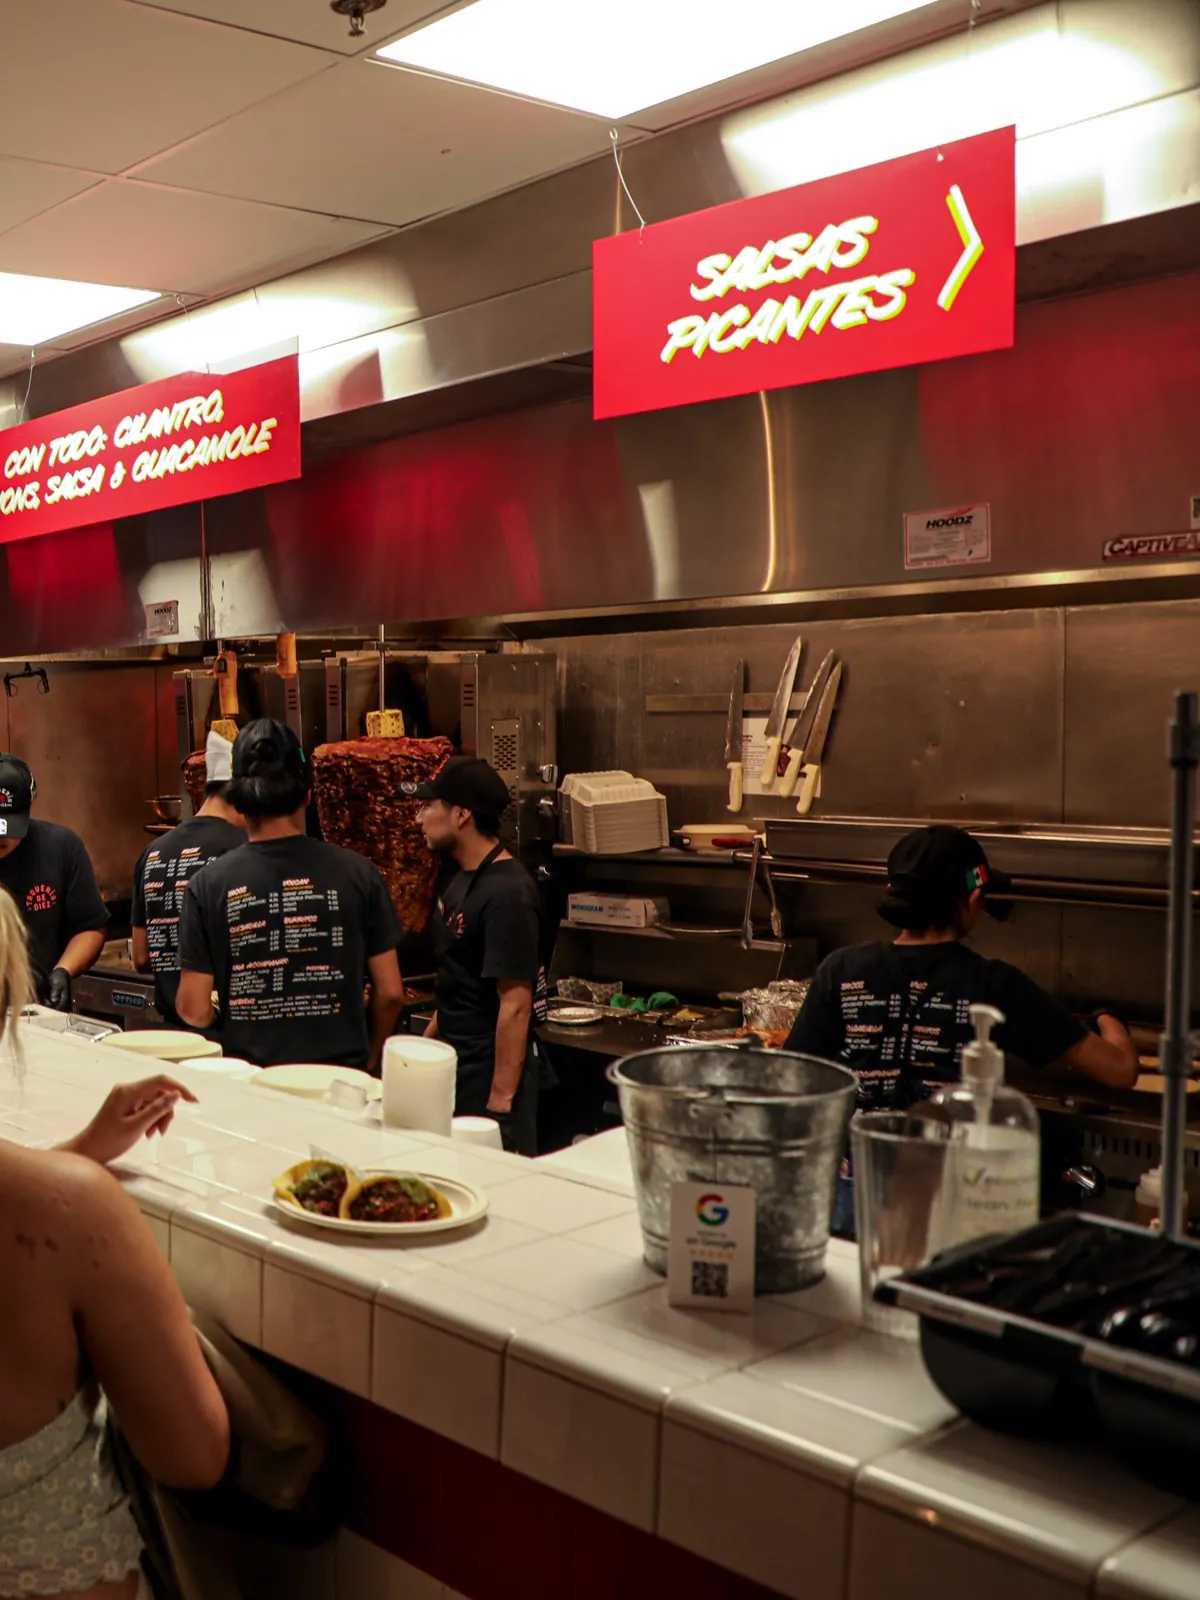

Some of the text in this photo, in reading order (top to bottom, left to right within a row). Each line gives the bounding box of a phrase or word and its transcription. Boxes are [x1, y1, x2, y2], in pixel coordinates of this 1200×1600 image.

[690, 215, 879, 302] SALSAS
[660, 267, 916, 364] PICANTES
[4, 389, 225, 479] CON TODO: CILANTRO,
[44, 463, 106, 505] SALSA
[110, 461, 127, 489] &
[132, 417, 278, 482] GUACAMOLE
[925, 515, 974, 529] HOODZ
[33, 900, 52, 911] DIEZ
